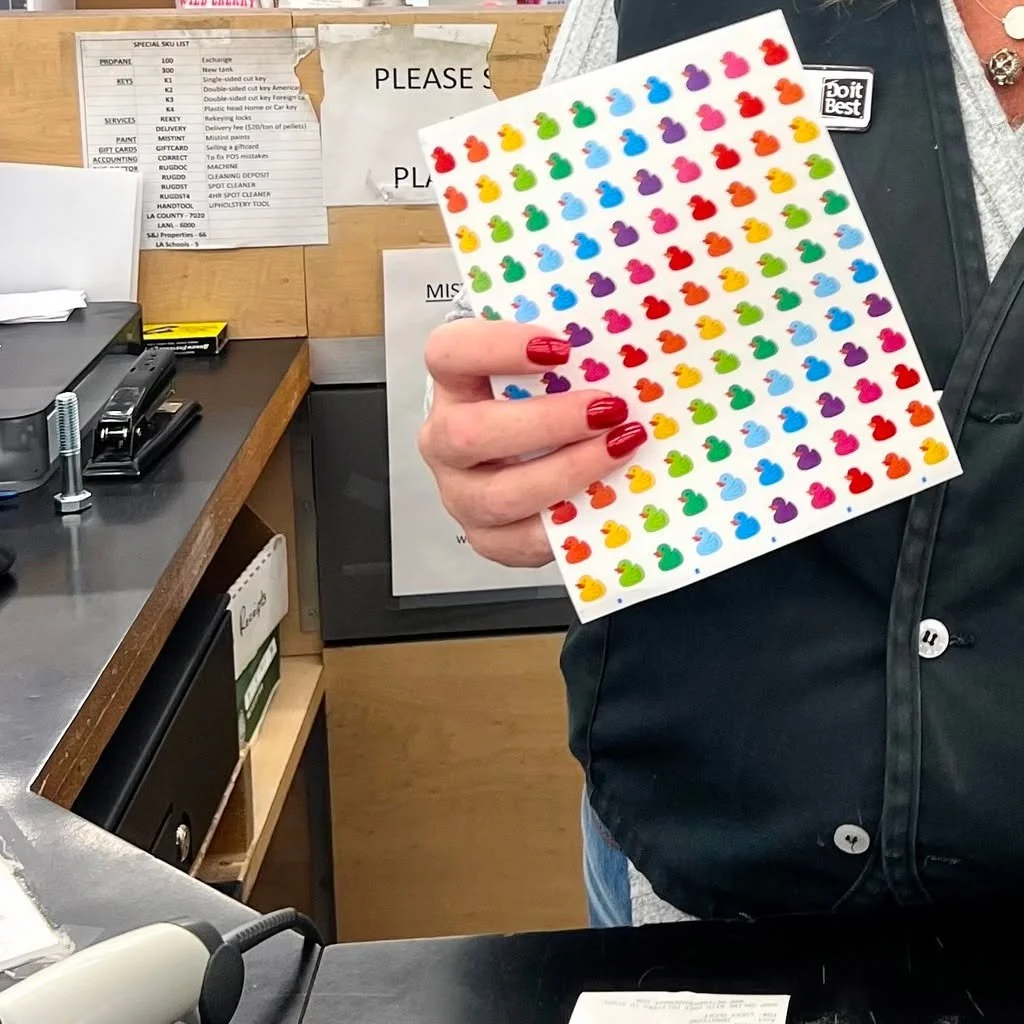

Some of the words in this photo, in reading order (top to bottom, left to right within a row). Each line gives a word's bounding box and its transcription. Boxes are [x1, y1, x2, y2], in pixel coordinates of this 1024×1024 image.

[99, 58, 132, 66] PROPANE
[201, 56, 233, 64] Exchange
[202, 76, 242, 84] Single-sided
[255, 75, 267, 83] key
[375, 67, 473, 89] PLEASE
[203, 85, 247, 93] Double-sided
[204, 95, 247, 103] Double-sided
[272, 93, 297, 102] Foreign
[226, 104, 243, 112] head
[273, 103, 285, 111] Car
[286, 103, 298, 111] key
[825, 97, 862, 116] Best
[204, 115, 235, 123] Rekeying
[235, 114, 252, 122] locks
[205, 125, 232, 133] Delivery
[116, 136, 137, 144] PAINT
[205, 134, 229, 142] Mistint
[230, 134, 251, 142] paints
[98, 146, 113, 154] GIFT
[114, 146, 138, 154] CARDS
[155, 144, 189, 152] GIFTCARD
[92, 155, 139, 164] ACCOUNTING
[157, 154, 188, 162] CORRECT
[226, 152, 240, 160] POS
[158, 163, 187, 171] RUGDOC
[207, 172, 241, 180] CLEANING
[242, 171, 270, 179] DEPOSIT
[208, 182, 225, 190] SPOT
[226, 181, 256, 189] CLEANER
[223, 191, 240, 199] SPOT
[241, 190, 271, 198] CLEANER
[208, 200, 251, 209] UPHOLSTERY
[252, 200, 271, 208] TOOL
[160, 231, 194, 240] Properties
